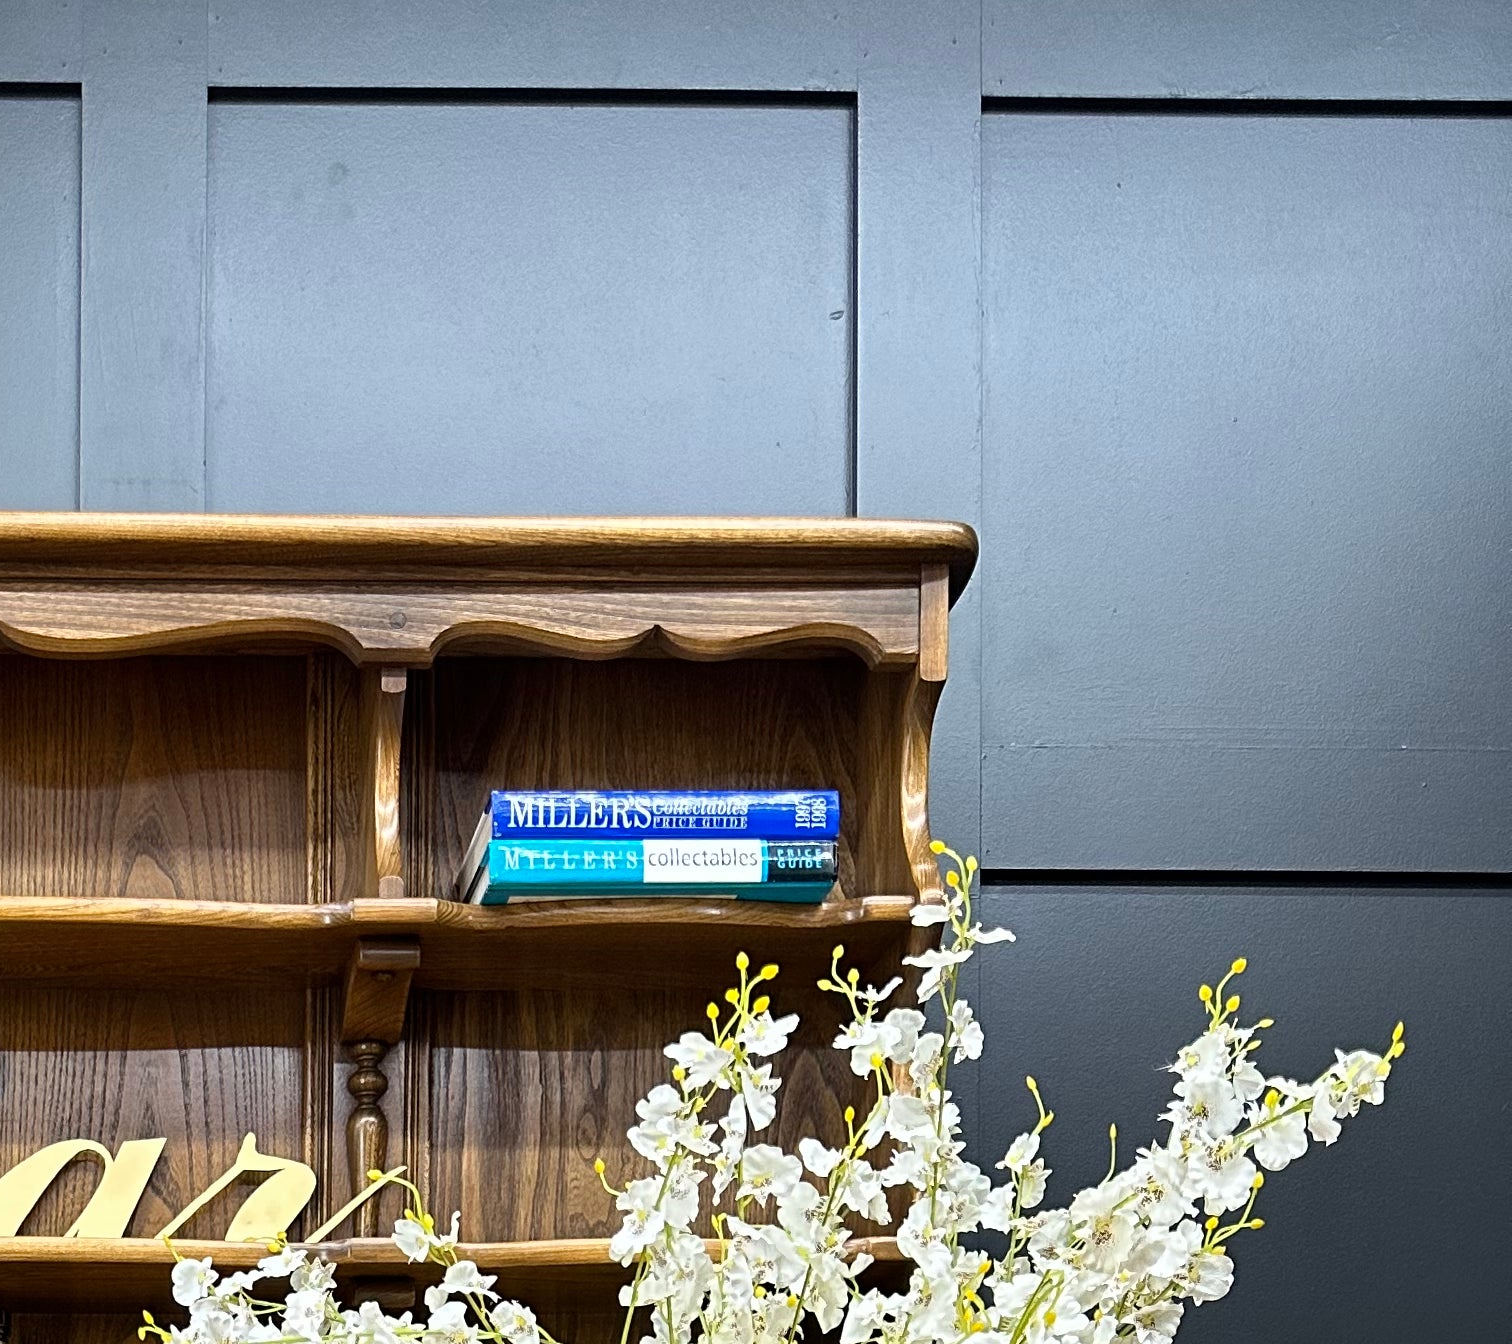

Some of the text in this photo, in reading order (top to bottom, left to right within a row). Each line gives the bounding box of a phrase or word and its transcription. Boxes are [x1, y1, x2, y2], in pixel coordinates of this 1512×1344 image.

[508, 796, 748, 829] MILLER'S Collectables
[811, 797, 826, 829] 1998
[653, 817, 748, 829] PRICE GUIDE
[504, 847, 759, 870] MILLER'S collectables
[776, 848, 822, 858] PRICE
[776, 858, 822, 869] GUIDE
